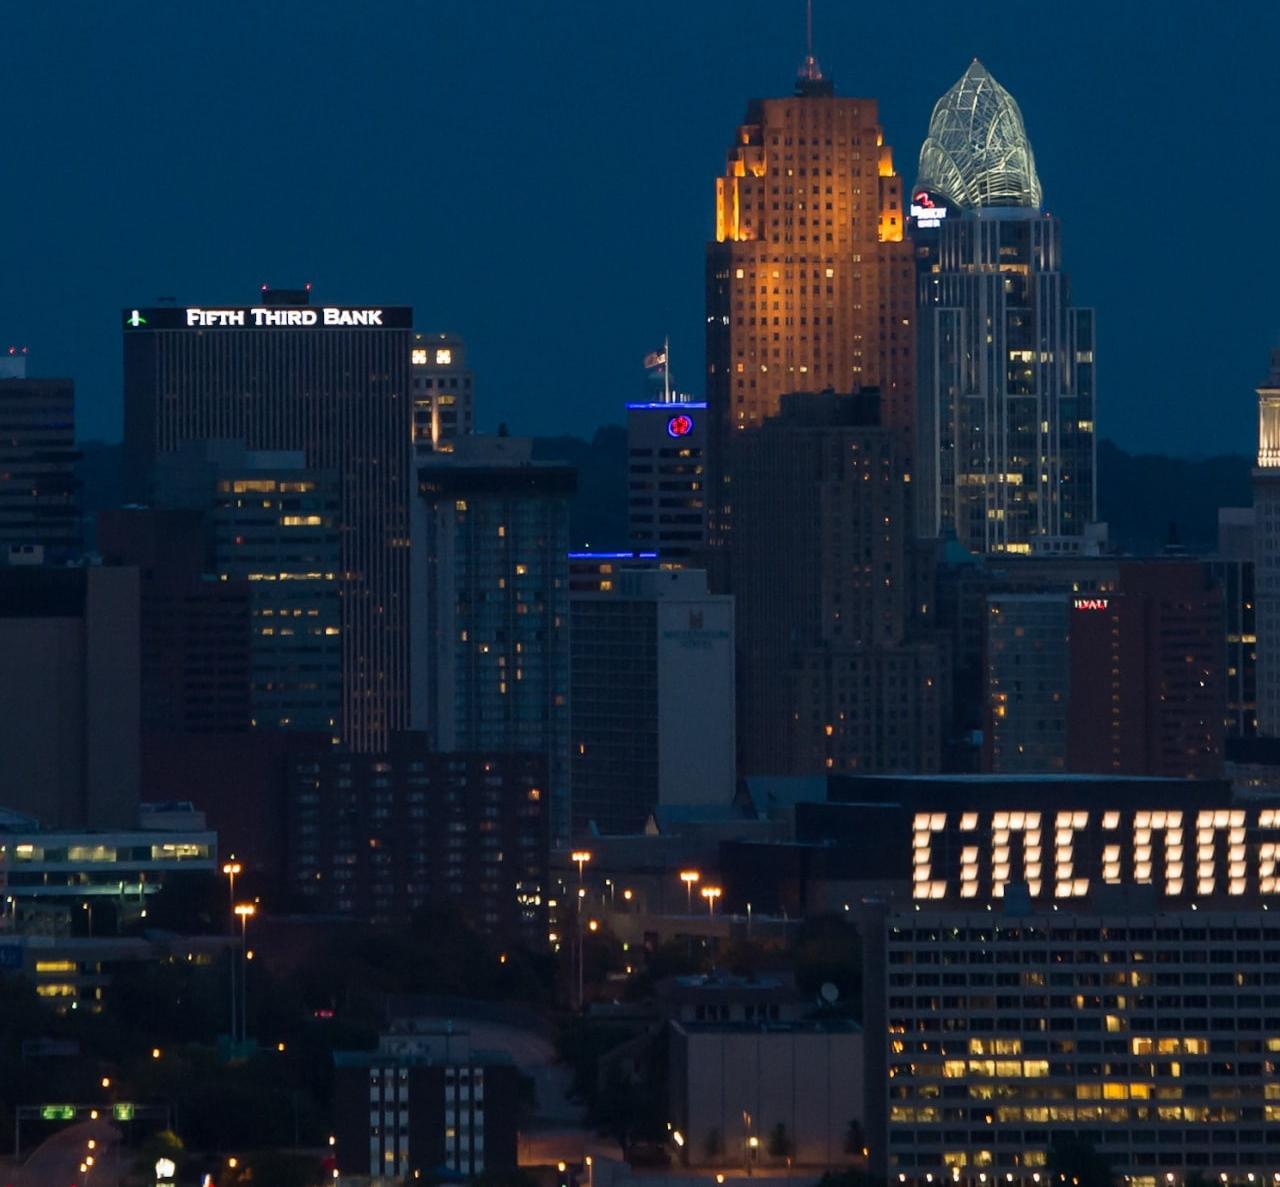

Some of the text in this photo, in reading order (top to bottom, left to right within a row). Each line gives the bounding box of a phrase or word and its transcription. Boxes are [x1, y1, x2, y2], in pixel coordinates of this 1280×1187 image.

[186, 308, 383, 326] FIFTH THIRD BANK
